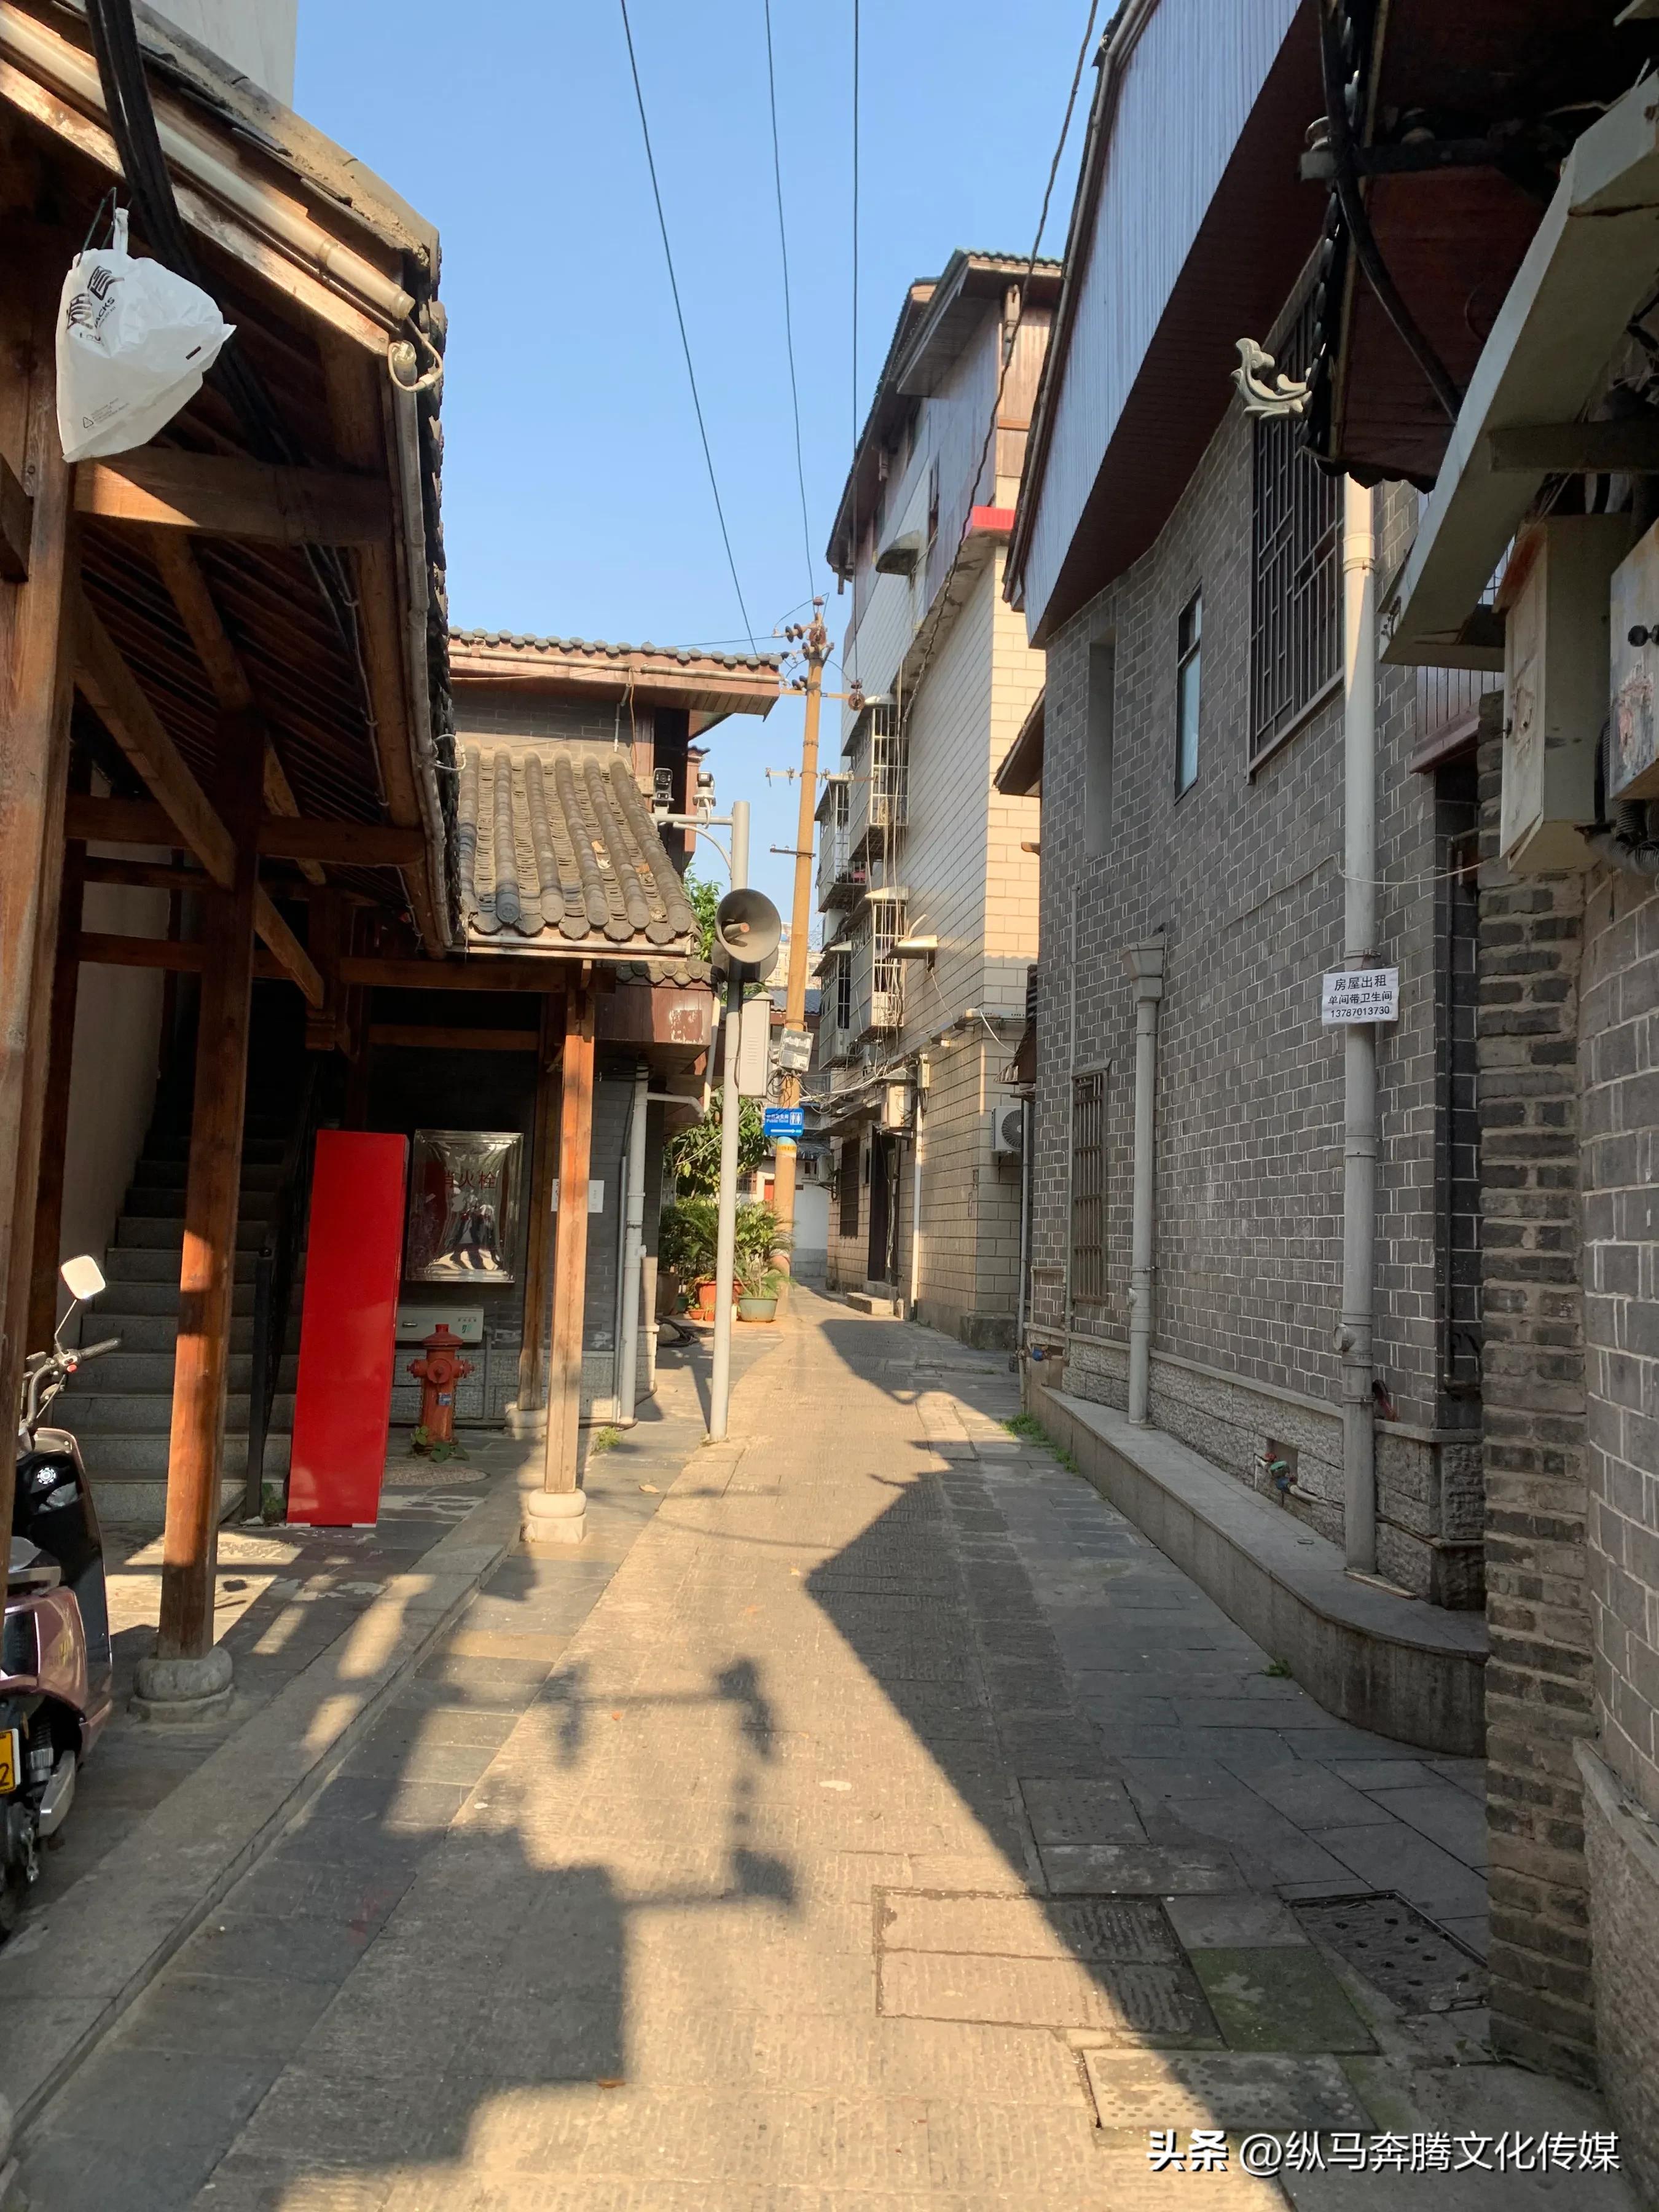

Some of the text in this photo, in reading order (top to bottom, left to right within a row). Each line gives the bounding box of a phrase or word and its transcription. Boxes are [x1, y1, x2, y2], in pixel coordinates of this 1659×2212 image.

[1335, 975, 1387, 991] 房屋出租
[1328, 990, 1392, 1005] 单间带卫生间
[1331, 1006, 1390, 1018] 13787013730
